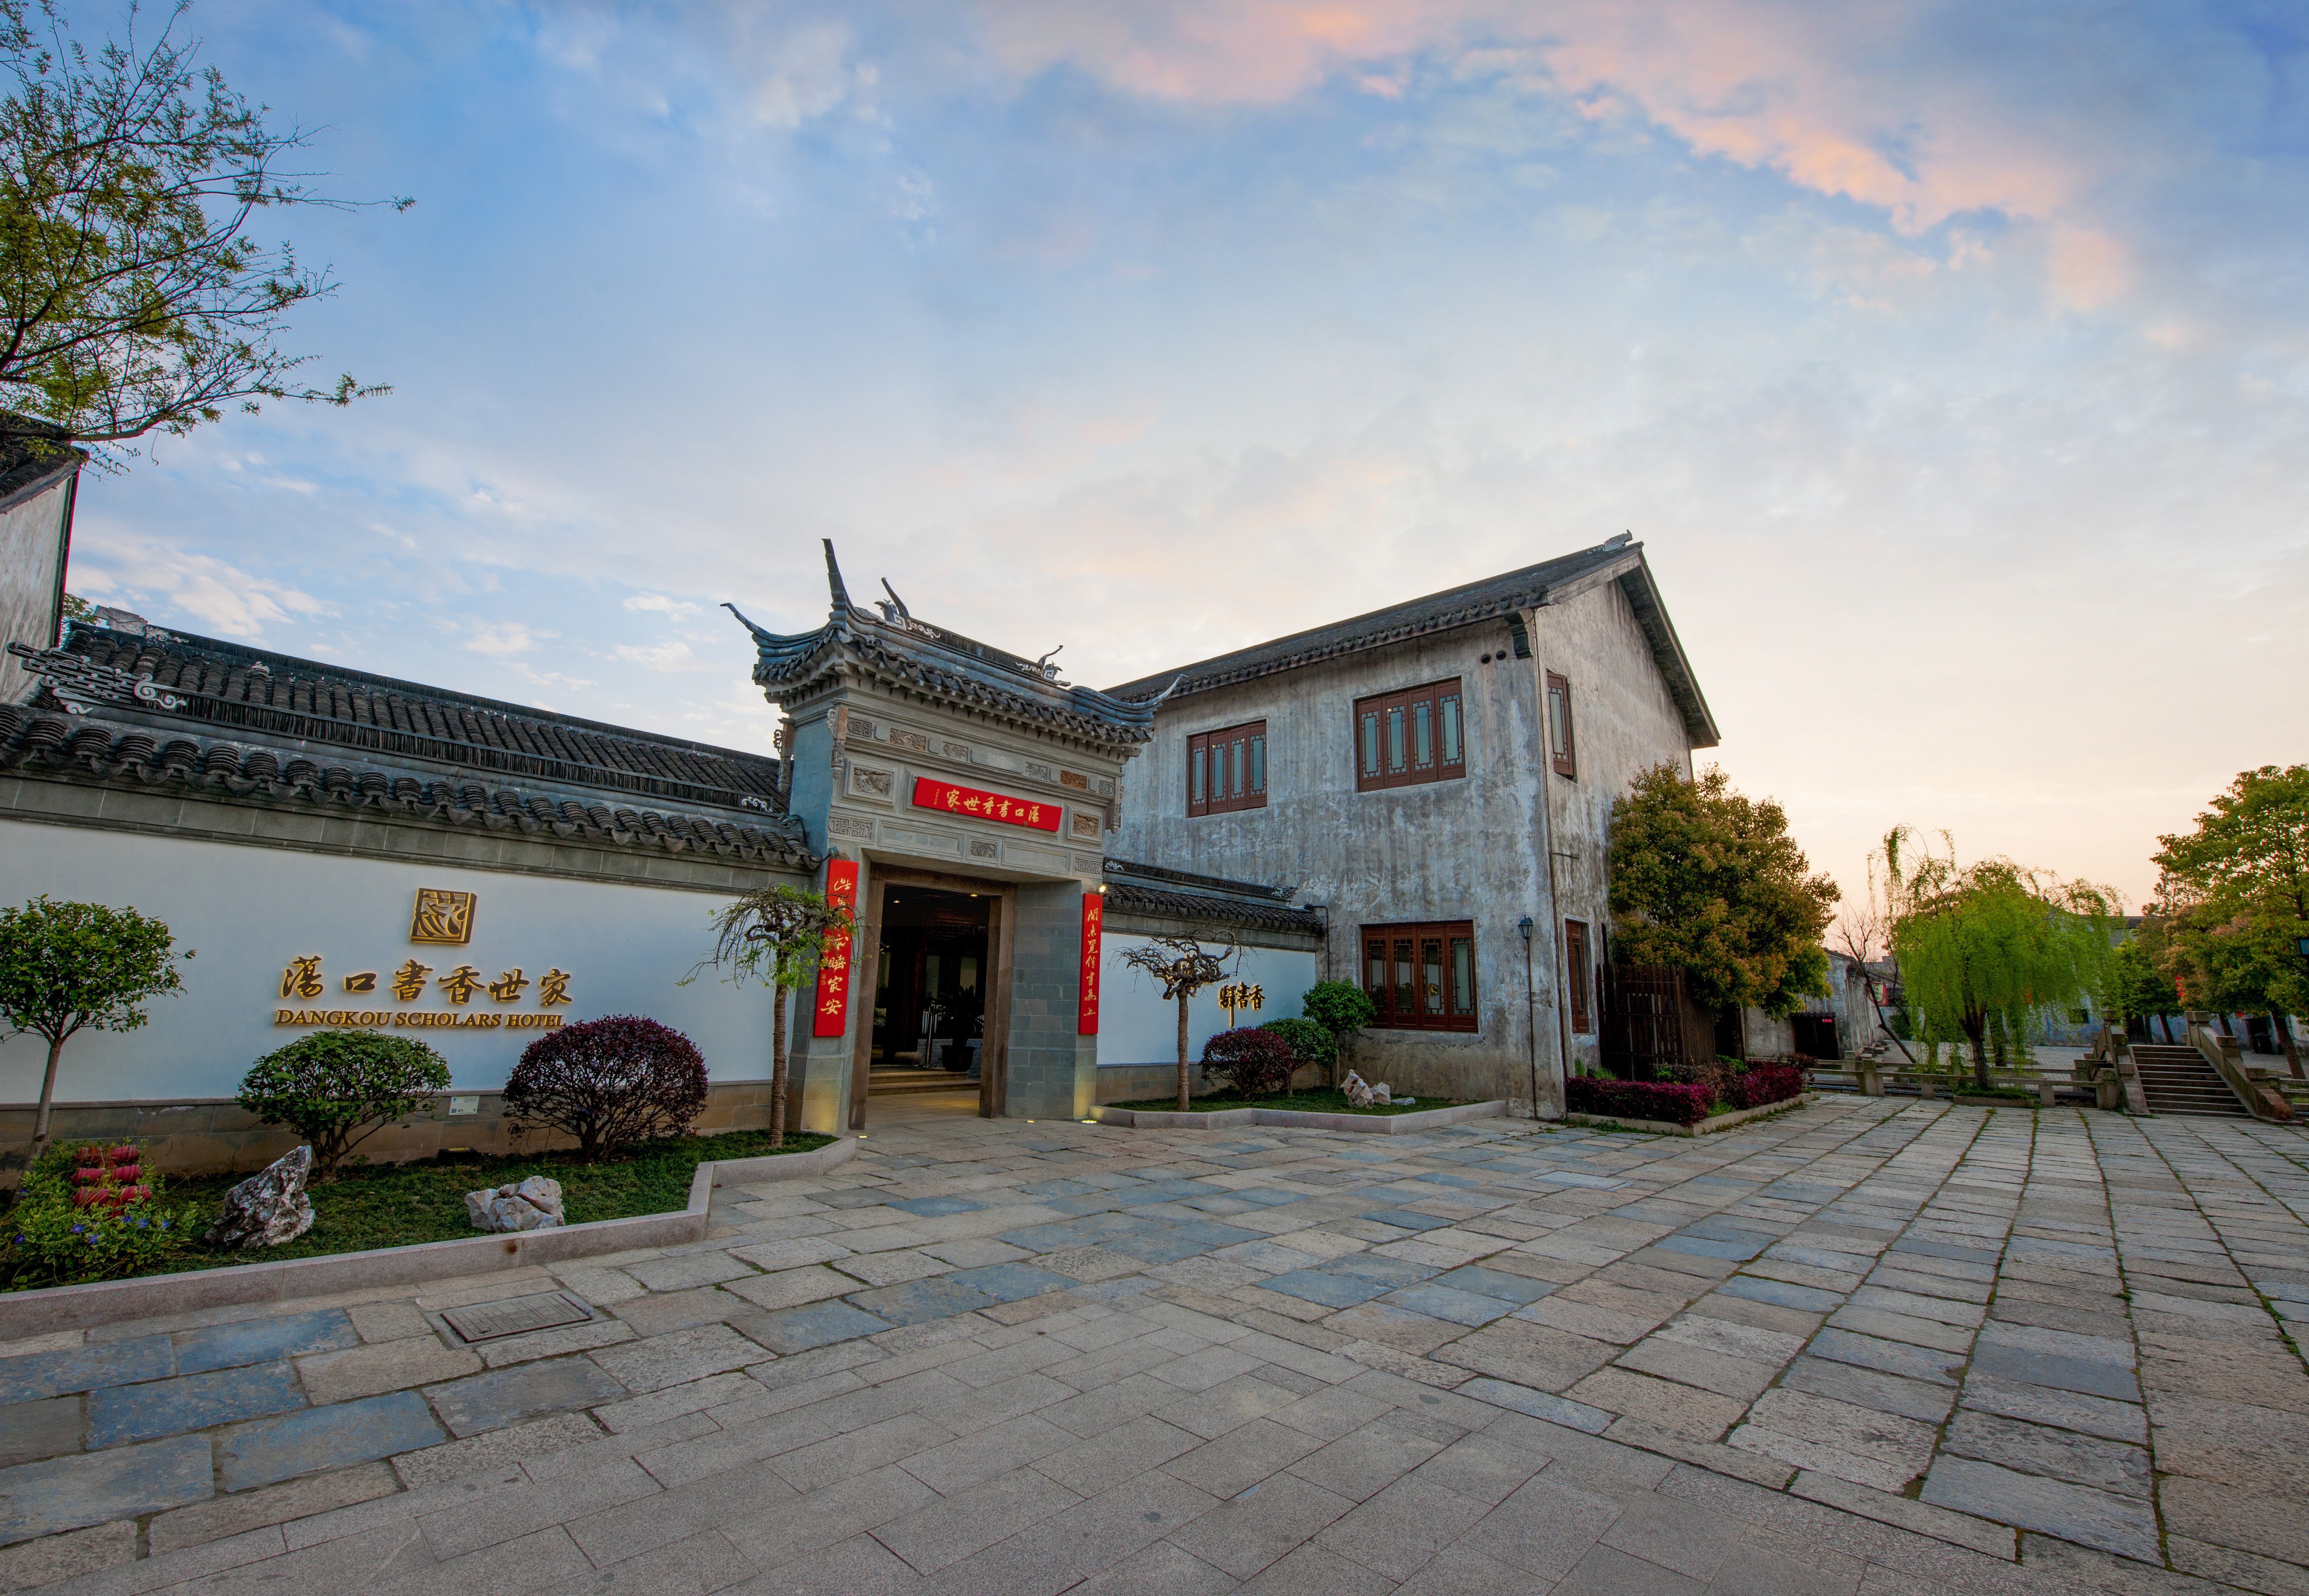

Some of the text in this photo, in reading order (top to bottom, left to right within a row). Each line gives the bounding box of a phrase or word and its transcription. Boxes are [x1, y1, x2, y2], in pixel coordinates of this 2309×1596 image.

[275, 1009, 566, 1028] DANGKOU SCHOLARS HOTEL
